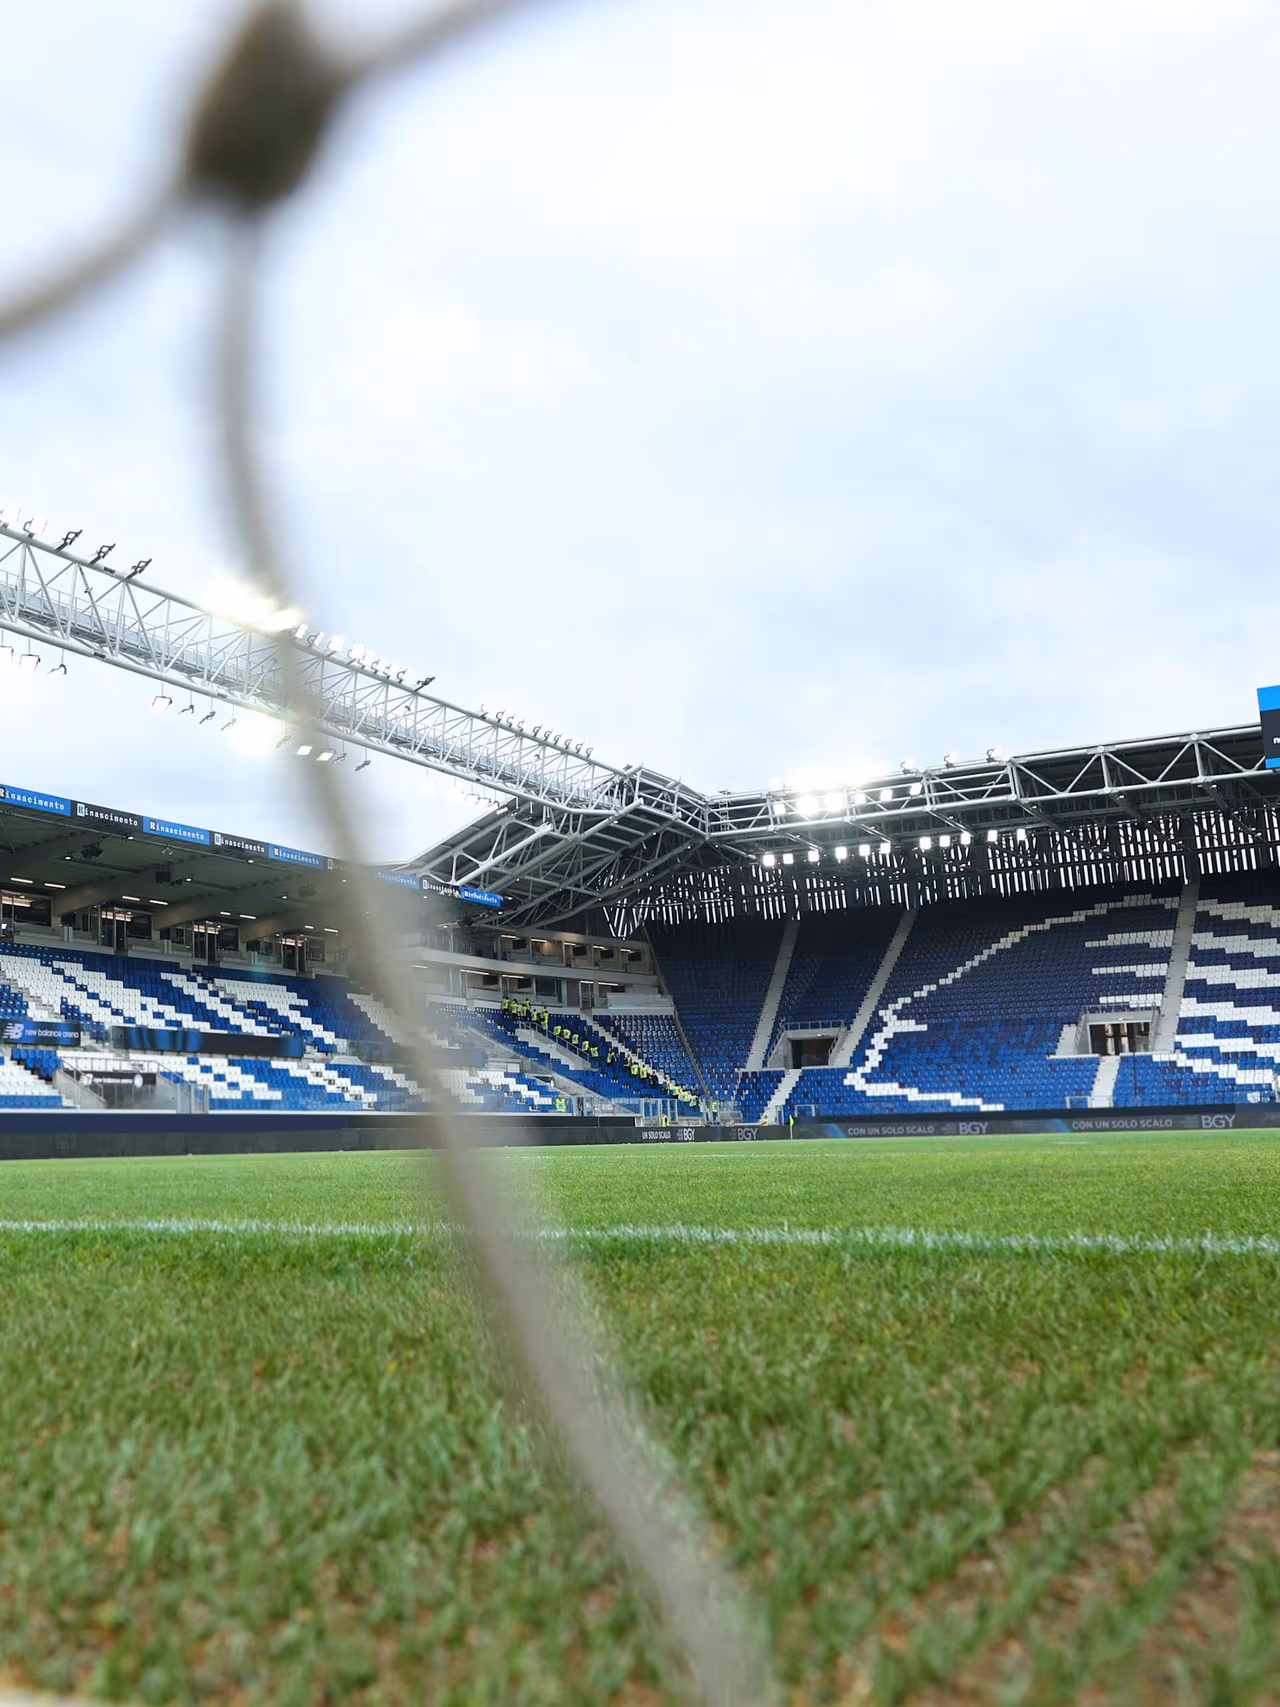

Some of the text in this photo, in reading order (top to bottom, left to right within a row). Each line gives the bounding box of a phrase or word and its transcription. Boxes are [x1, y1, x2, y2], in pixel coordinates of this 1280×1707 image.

[76, 802, 138, 826] Rinascimento
[149, 820, 205, 840] Rinascimento
[215, 833, 265, 853] Rinascimento
[38, 1028, 61, 1037] balance
[958, 1121, 989, 1135] BGY
[1072, 1121, 1094, 1130] CON
[1094, 1120, 1109, 1129] UN
[1111, 1119, 1138, 1129] SOLO
[1140, 1118, 1173, 1128] SCALO
[1201, 1114, 1236, 1129] BGY
[683, 1128, 695, 1141] BGY
[737, 1127, 758, 1140] BGY
[847, 1127, 866, 1136] CON
[867, 1127, 880, 1135] UN
[881, 1126, 904, 1135] SOLO
[905, 1125, 935, 1134] SCALO
